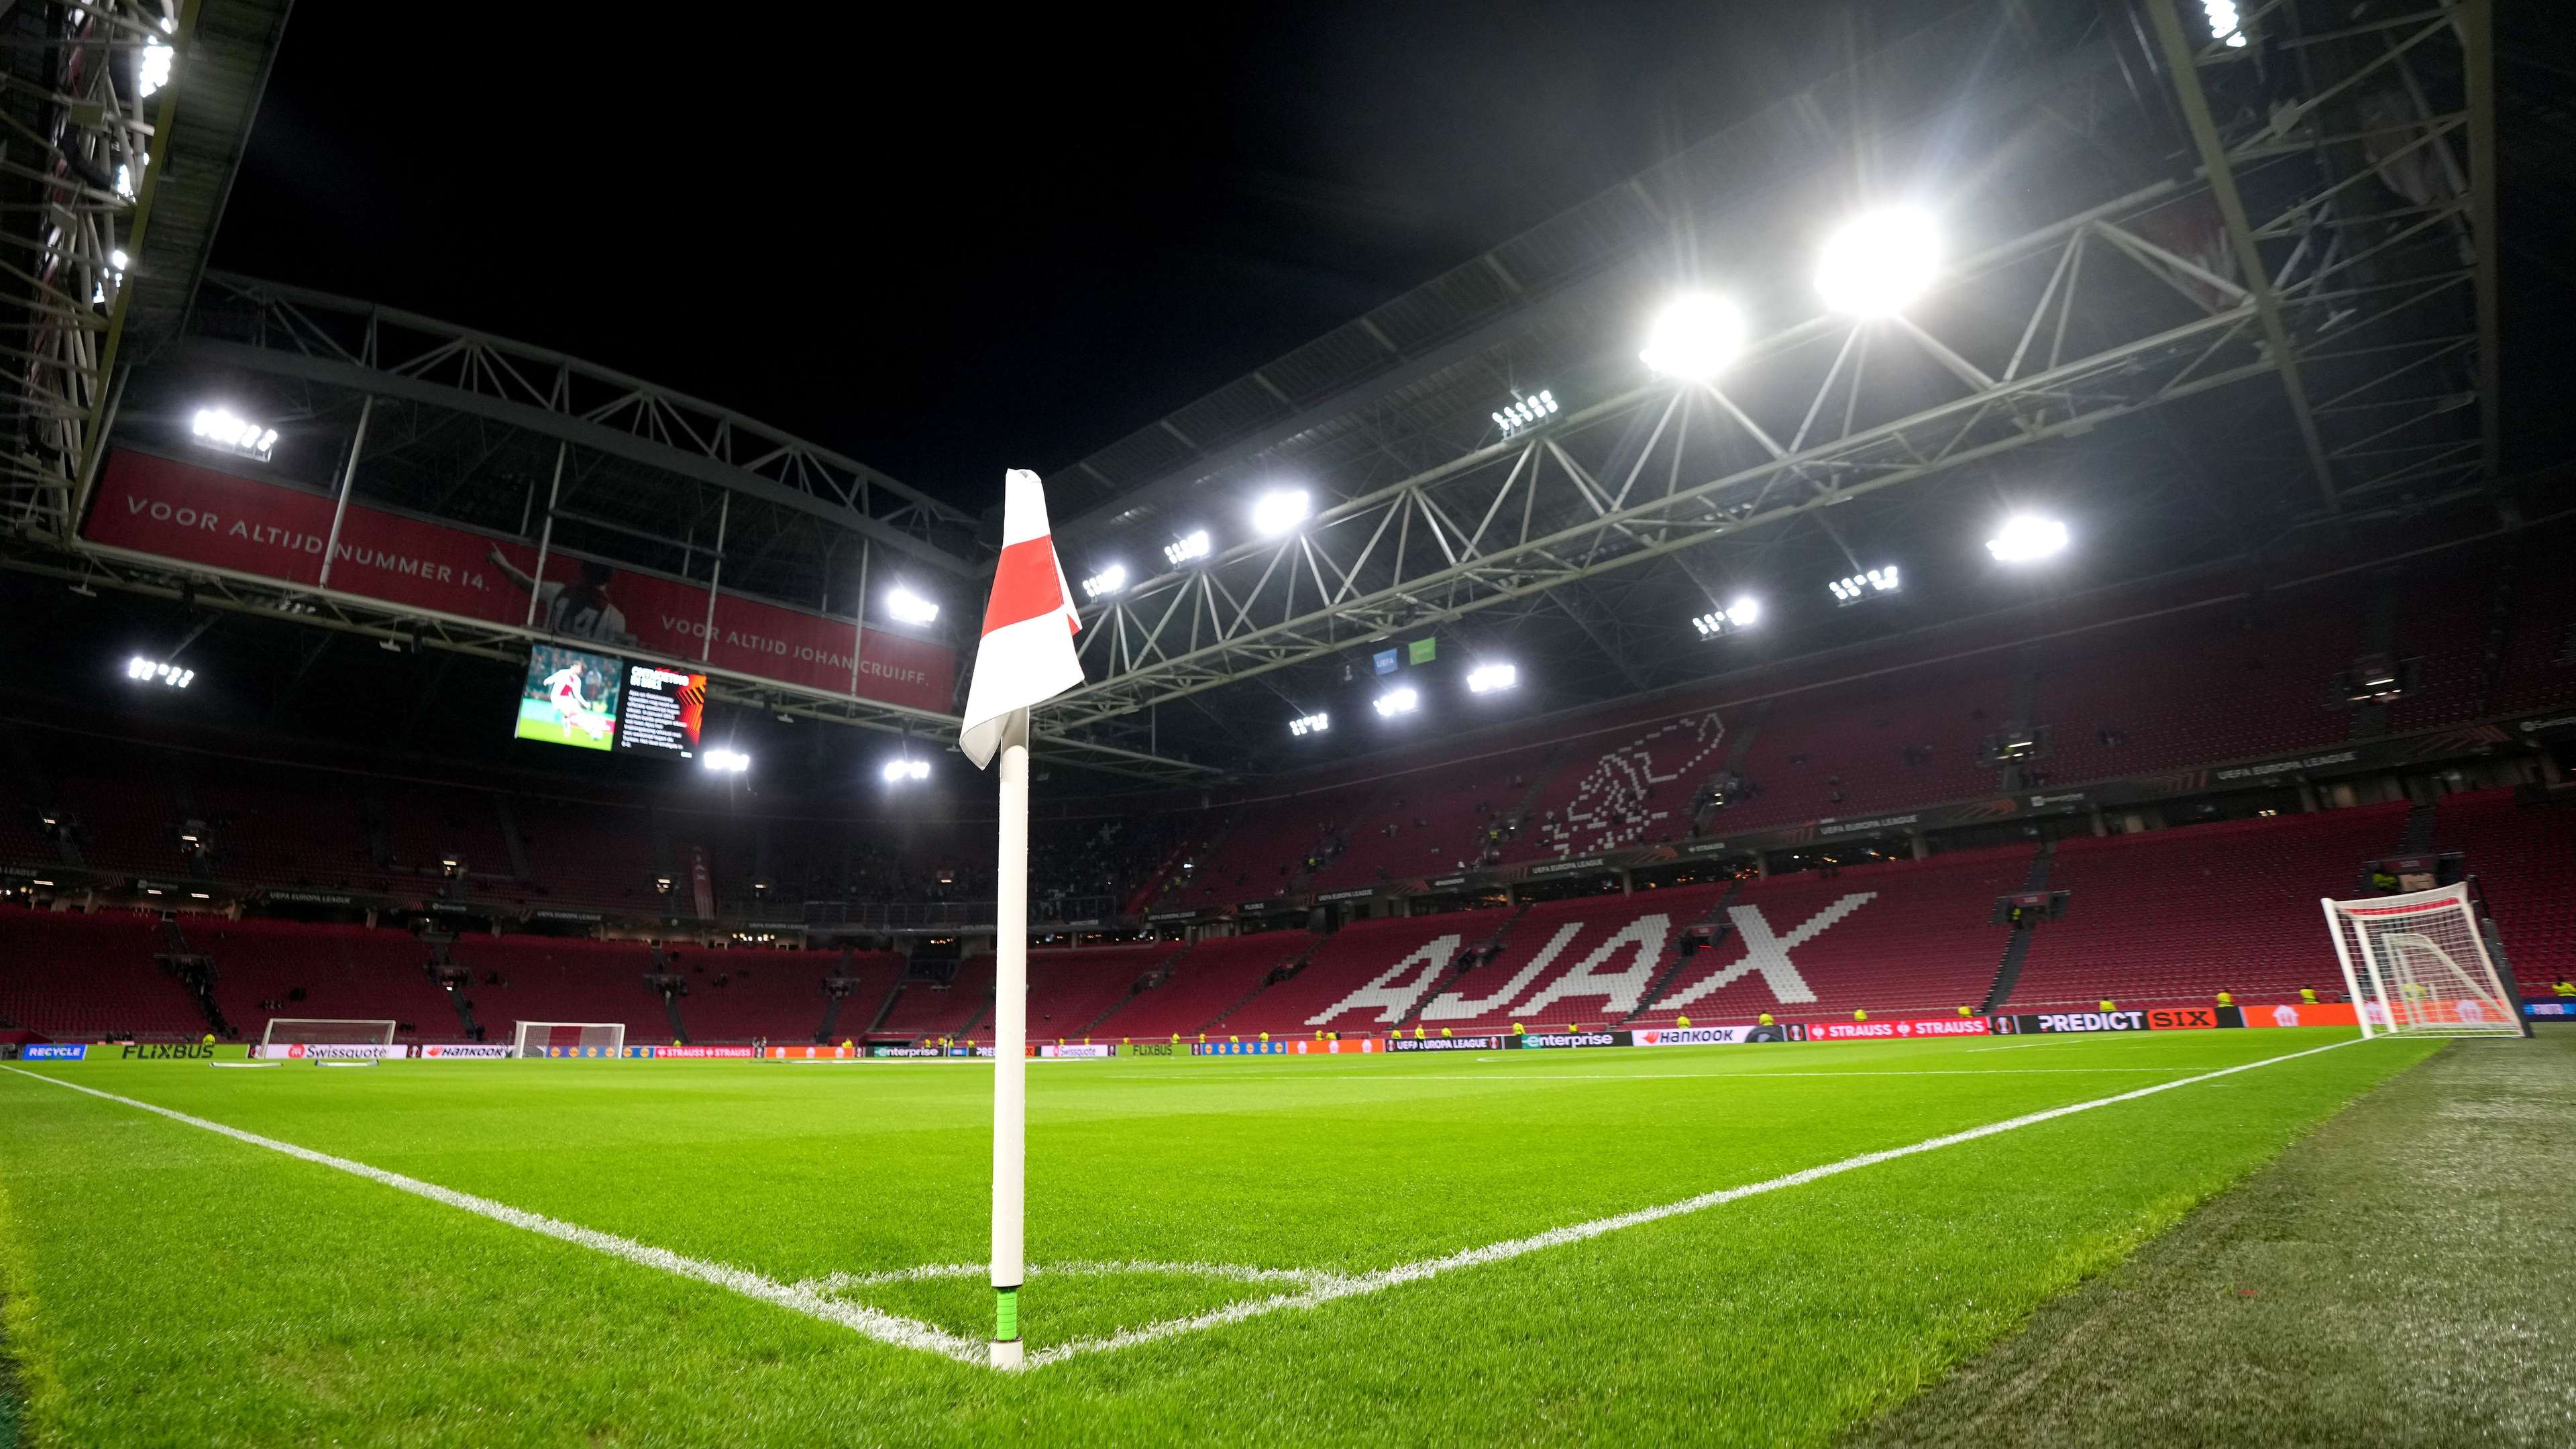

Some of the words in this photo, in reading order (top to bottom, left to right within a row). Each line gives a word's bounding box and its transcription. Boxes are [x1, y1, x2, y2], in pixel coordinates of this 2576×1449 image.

[127, 494, 219, 532] VOOR
[229, 519, 323, 554] ALTIJD
[335, 543, 451, 584] NUMMER
[661, 613, 720, 642] VOOR
[726, 631, 787, 655] ALTIJD
[793, 645, 853, 670] JOHAN
[859, 660, 929, 687] CRUIJFF.
[1376, 657, 1395, 667] UEFA
[1820, 826, 1845, 835] UEFA
[1881, 814, 1919, 826] LEAGUE
[1303, 891, 1877, 1025] AJAX
[1829, 1023, 1893, 1037] STRAUSS
[1916, 1020, 1984, 1035] STRAUSS
[2038, 1011, 2143, 1033] PREDICT
[2154, 1010, 2211, 1028] SIX
[1396, 1040, 1417, 1050] UEFA
[1453, 1038, 1487, 1049] LEAGUE
[1525, 1032, 1613, 1049] enterprise
[29, 1047, 81, 1057] RECYCLE
[307, 1044, 387, 1059] Swissquote
[667, 1048, 704, 1057] STRAUSS
[714, 1048, 751, 1057] STRAUSS
[877, 1046, 938, 1058] enterprise
